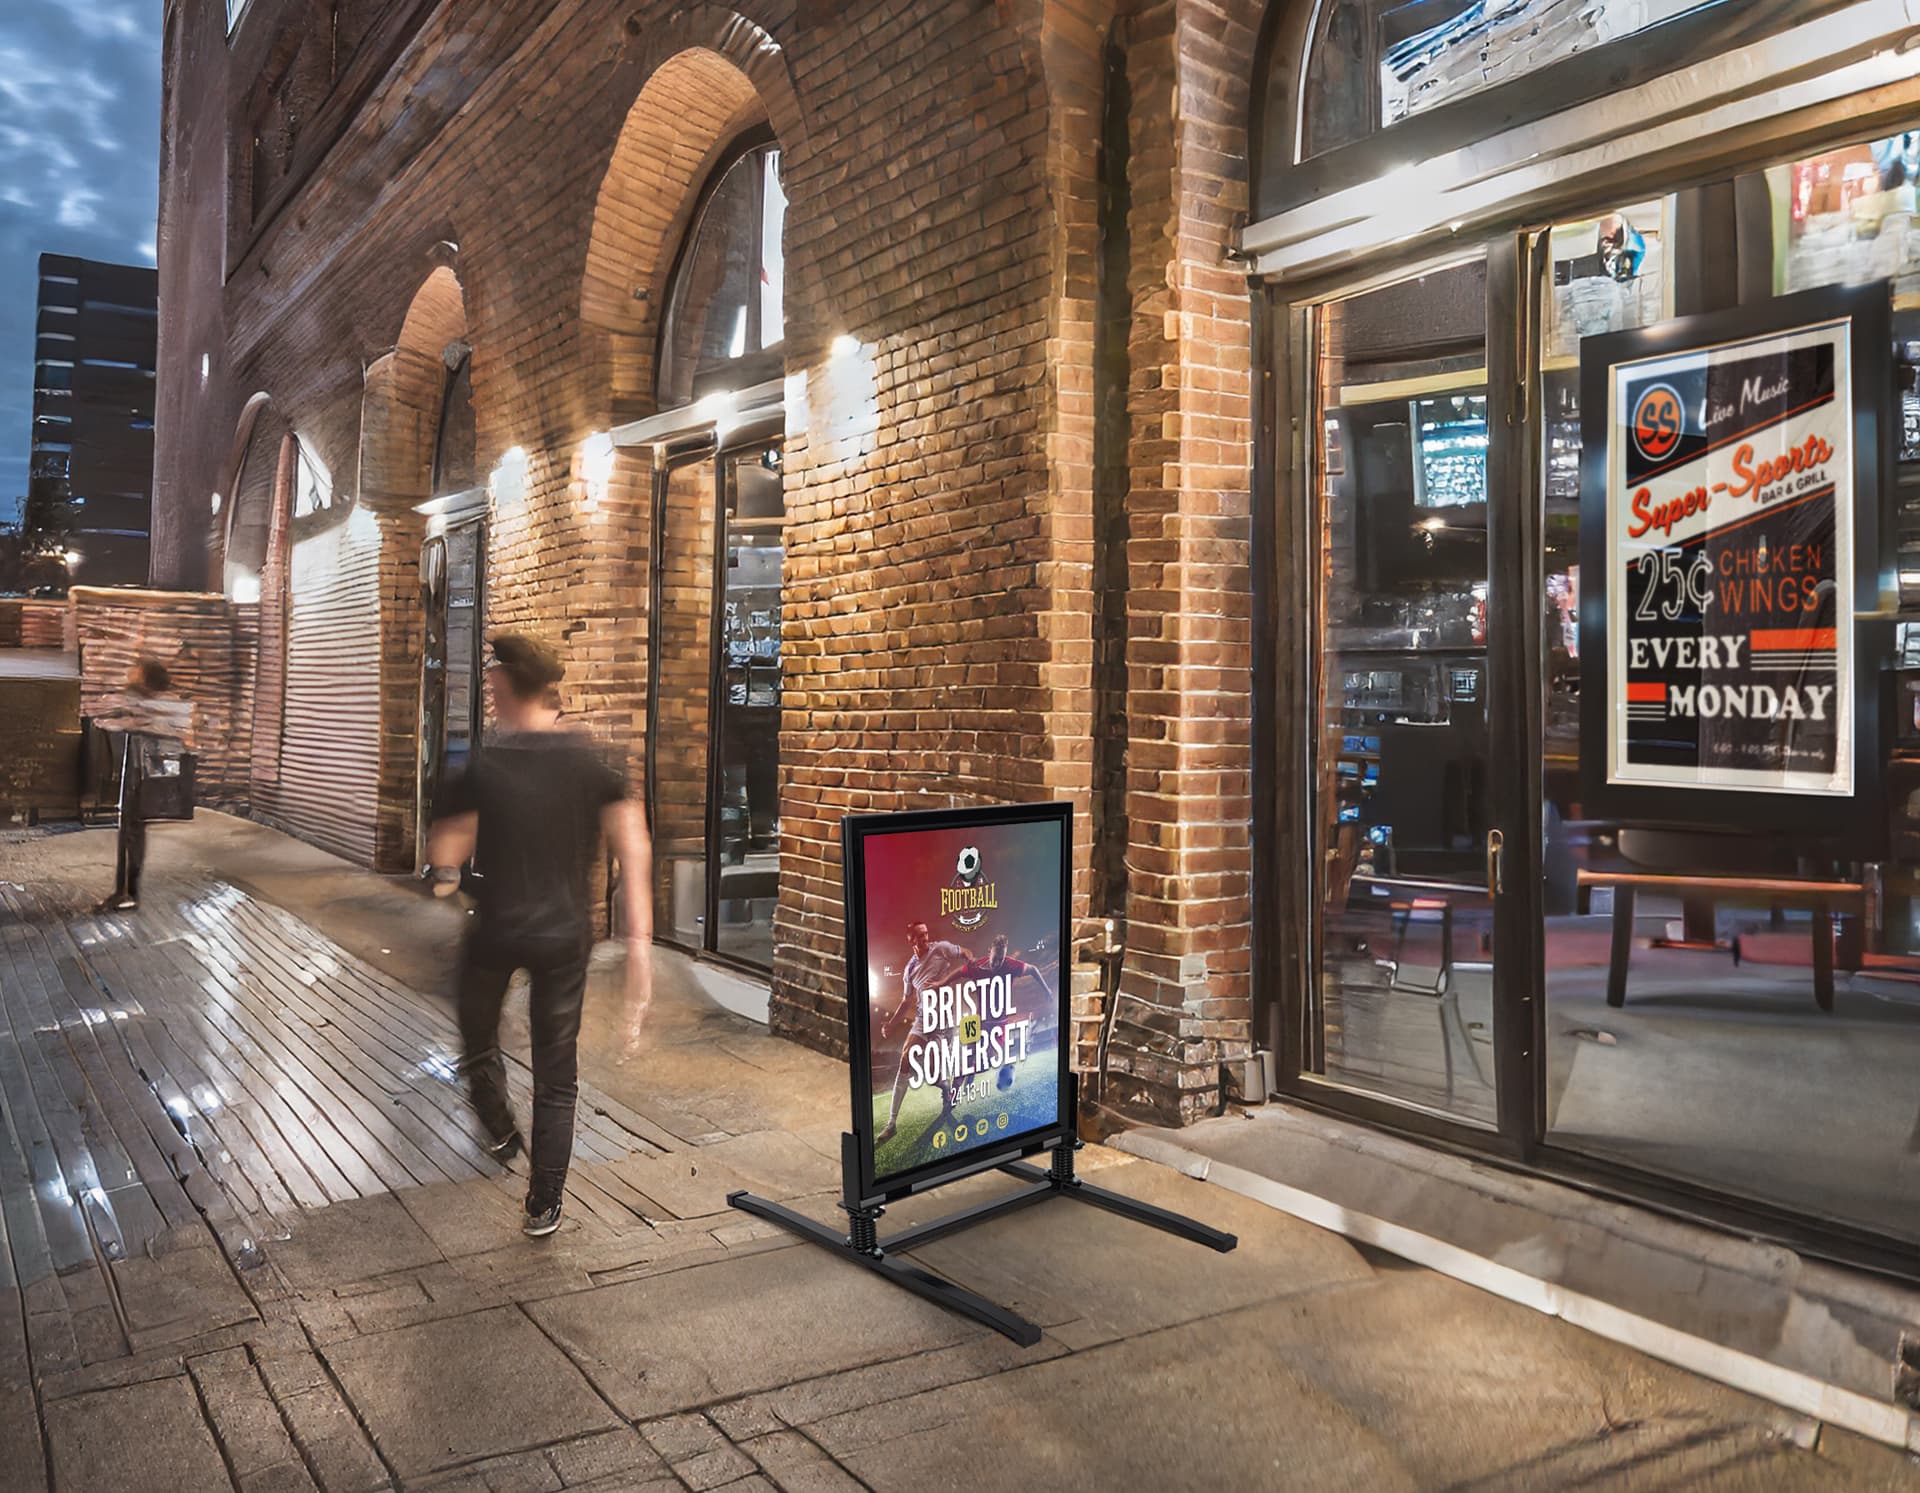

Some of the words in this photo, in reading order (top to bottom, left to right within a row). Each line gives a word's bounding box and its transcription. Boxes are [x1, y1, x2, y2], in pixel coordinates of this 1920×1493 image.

[1698, 398, 1735, 430] Live
[1740, 375, 1790, 416] Music
[1641, 401, 1680, 444] SS
[1761, 486, 1783, 504] BAR
[1785, 480, 1794, 495] &
[1796, 470, 1828, 491] GRILL
[1719, 545, 1821, 576] CHICKEN
[1719, 575, 1820, 615] WINGS
[1629, 635, 1747, 669] EVERY
[1669, 685, 1833, 720] MONDAY
[941, 882, 998, 916] FOOTBALL
[922, 974, 1017, 1034] BRISTOL
[964, 1020, 977, 1038] VS
[908, 1019, 1029, 1089] SOMERSET
